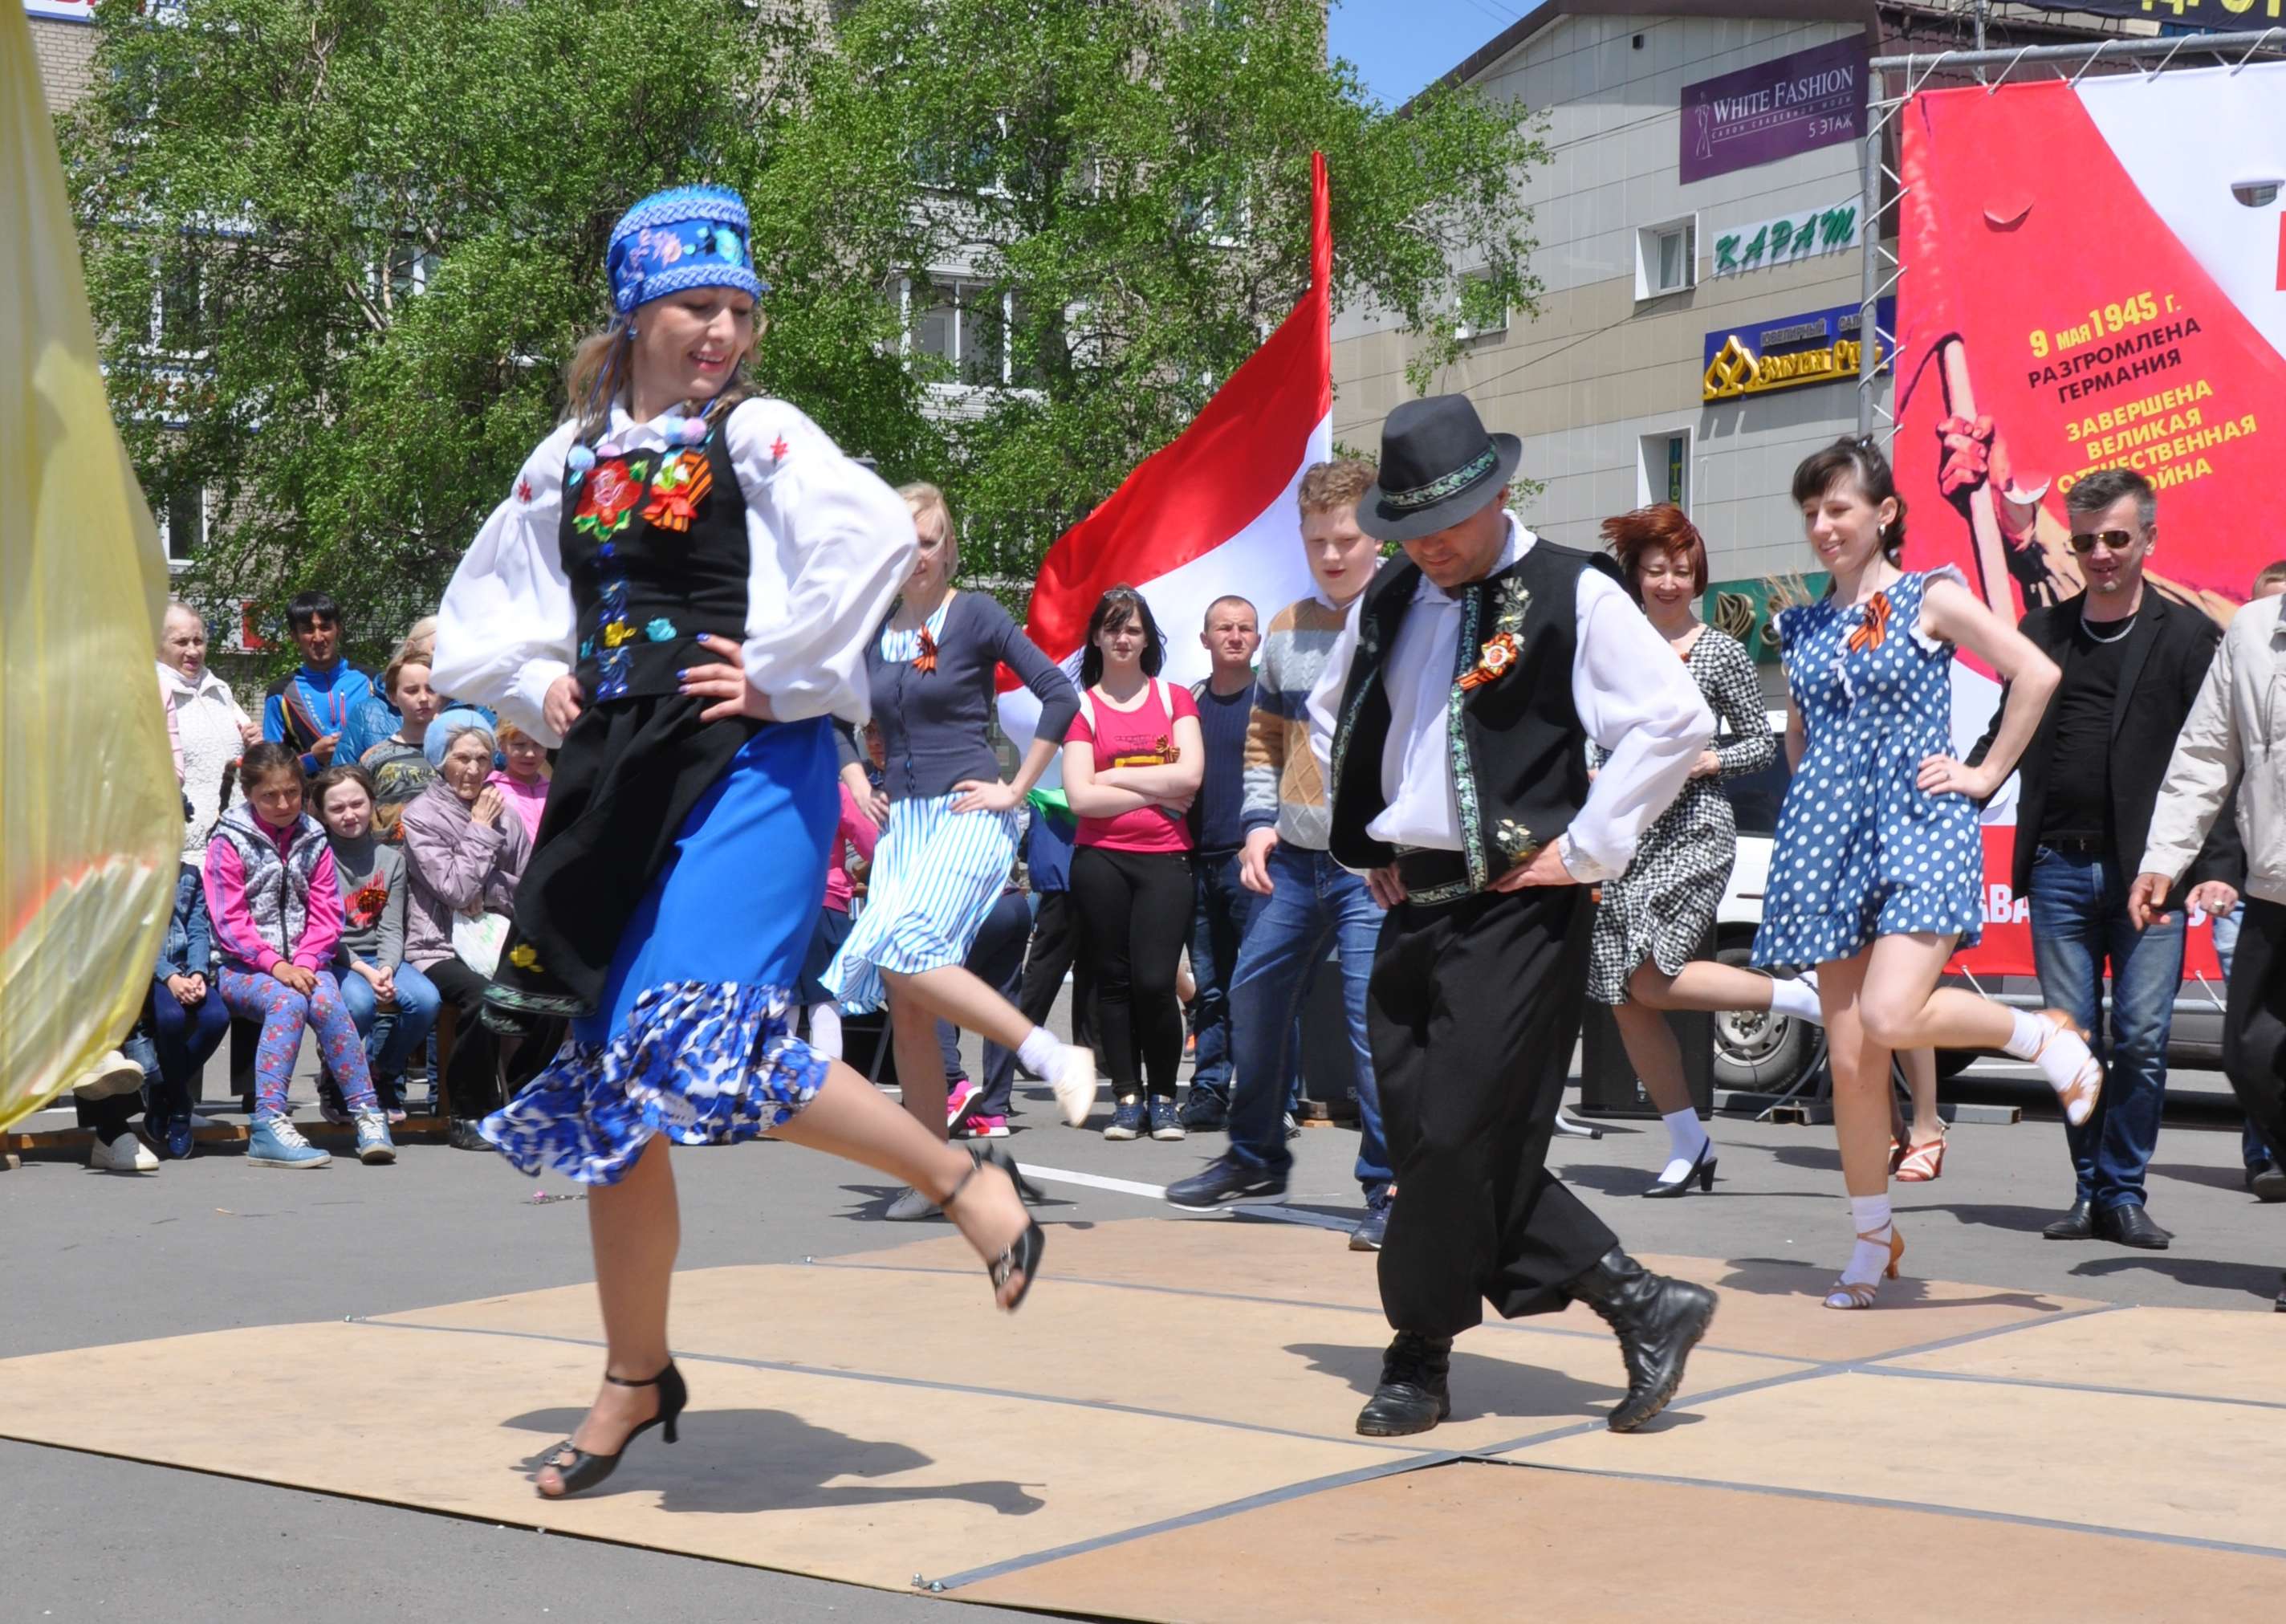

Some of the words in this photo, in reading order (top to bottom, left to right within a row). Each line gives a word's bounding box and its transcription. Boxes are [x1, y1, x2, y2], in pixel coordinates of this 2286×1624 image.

[1713, 89, 1770, 124] WHITE
[1774, 65, 1854, 108] FASHION
[1711, 125, 1744, 140] САЛОН
[1808, 121, 1816, 138] 5
[1820, 112, 1853, 135] ЭТАЖ
[2028, 317, 2201, 389] РАЗГРОМЛЕНА
[2029, 329, 2049, 358] 9
[2089, 291, 2158, 338] 1945
[2057, 348, 2182, 404] ГЕРМАНИЯ
[2065, 379, 2213, 442] ЗАВЕРШЕНА
[2086, 407, 2203, 461] ВЕЛИКАЯ
[2056, 414, 2257, 494] ОЕСТВЕННАЯ
[2145, 458, 2213, 491] ОЙНА
